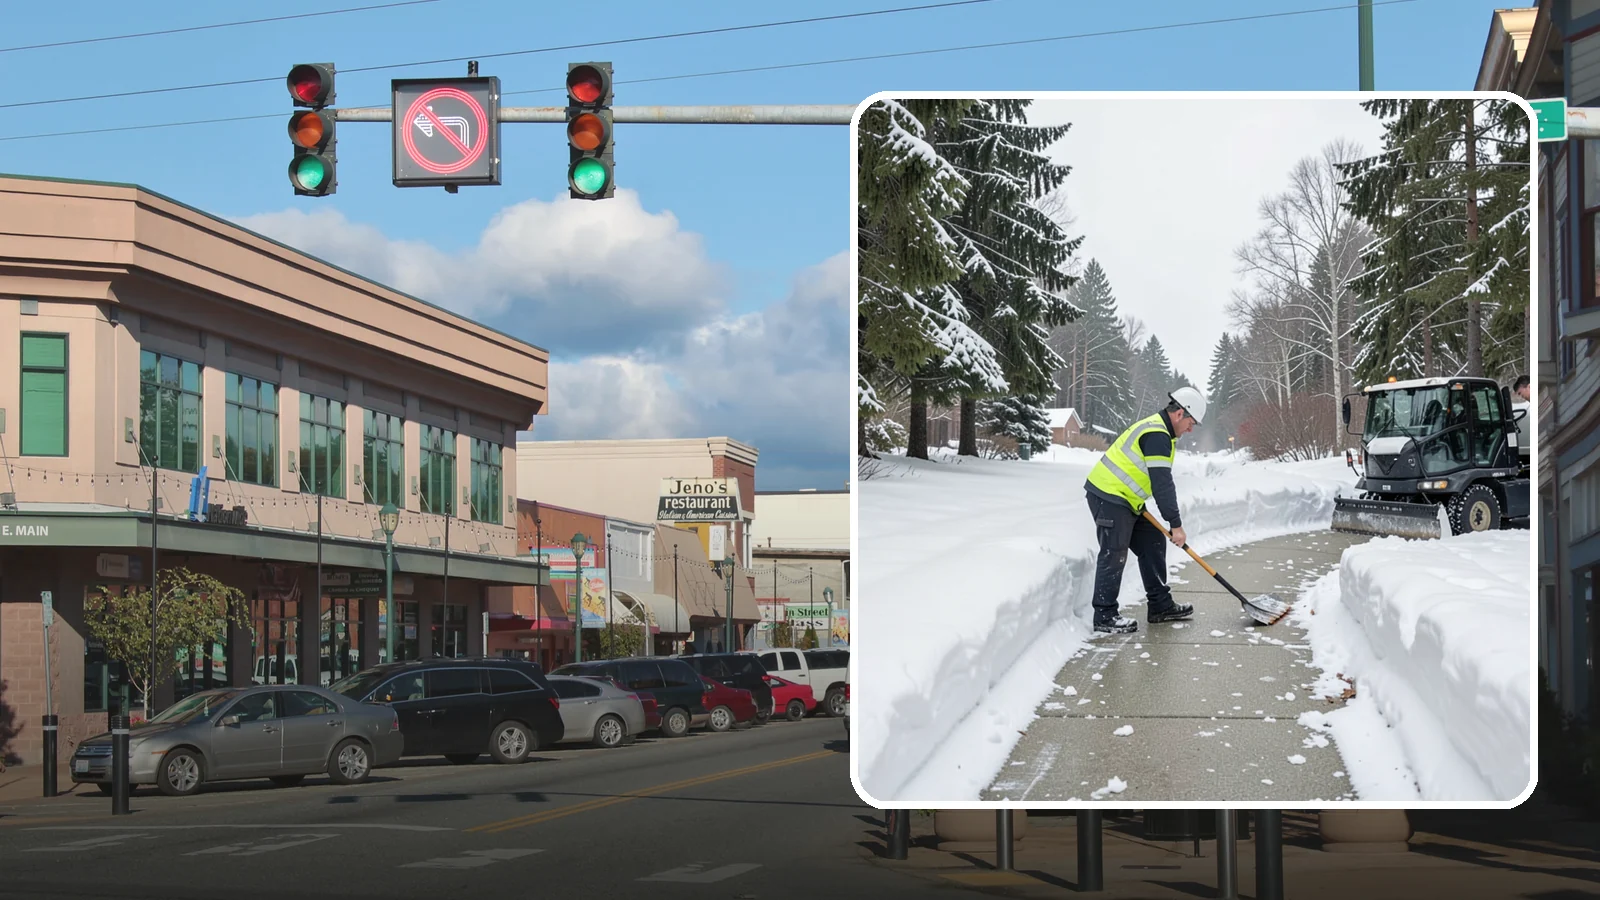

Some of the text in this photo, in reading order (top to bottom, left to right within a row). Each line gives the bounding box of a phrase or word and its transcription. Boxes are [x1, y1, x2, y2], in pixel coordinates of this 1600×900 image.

[669, 480, 728, 494] Jeno's
[665, 496, 731, 509] restaurant
[658, 509, 682, 519] Italian
[686, 509, 714, 519] American
[715, 509, 737, 519] Cuisine
[2, 525, 49, 536] E. MAIN
[797, 608, 828, 616] Street
